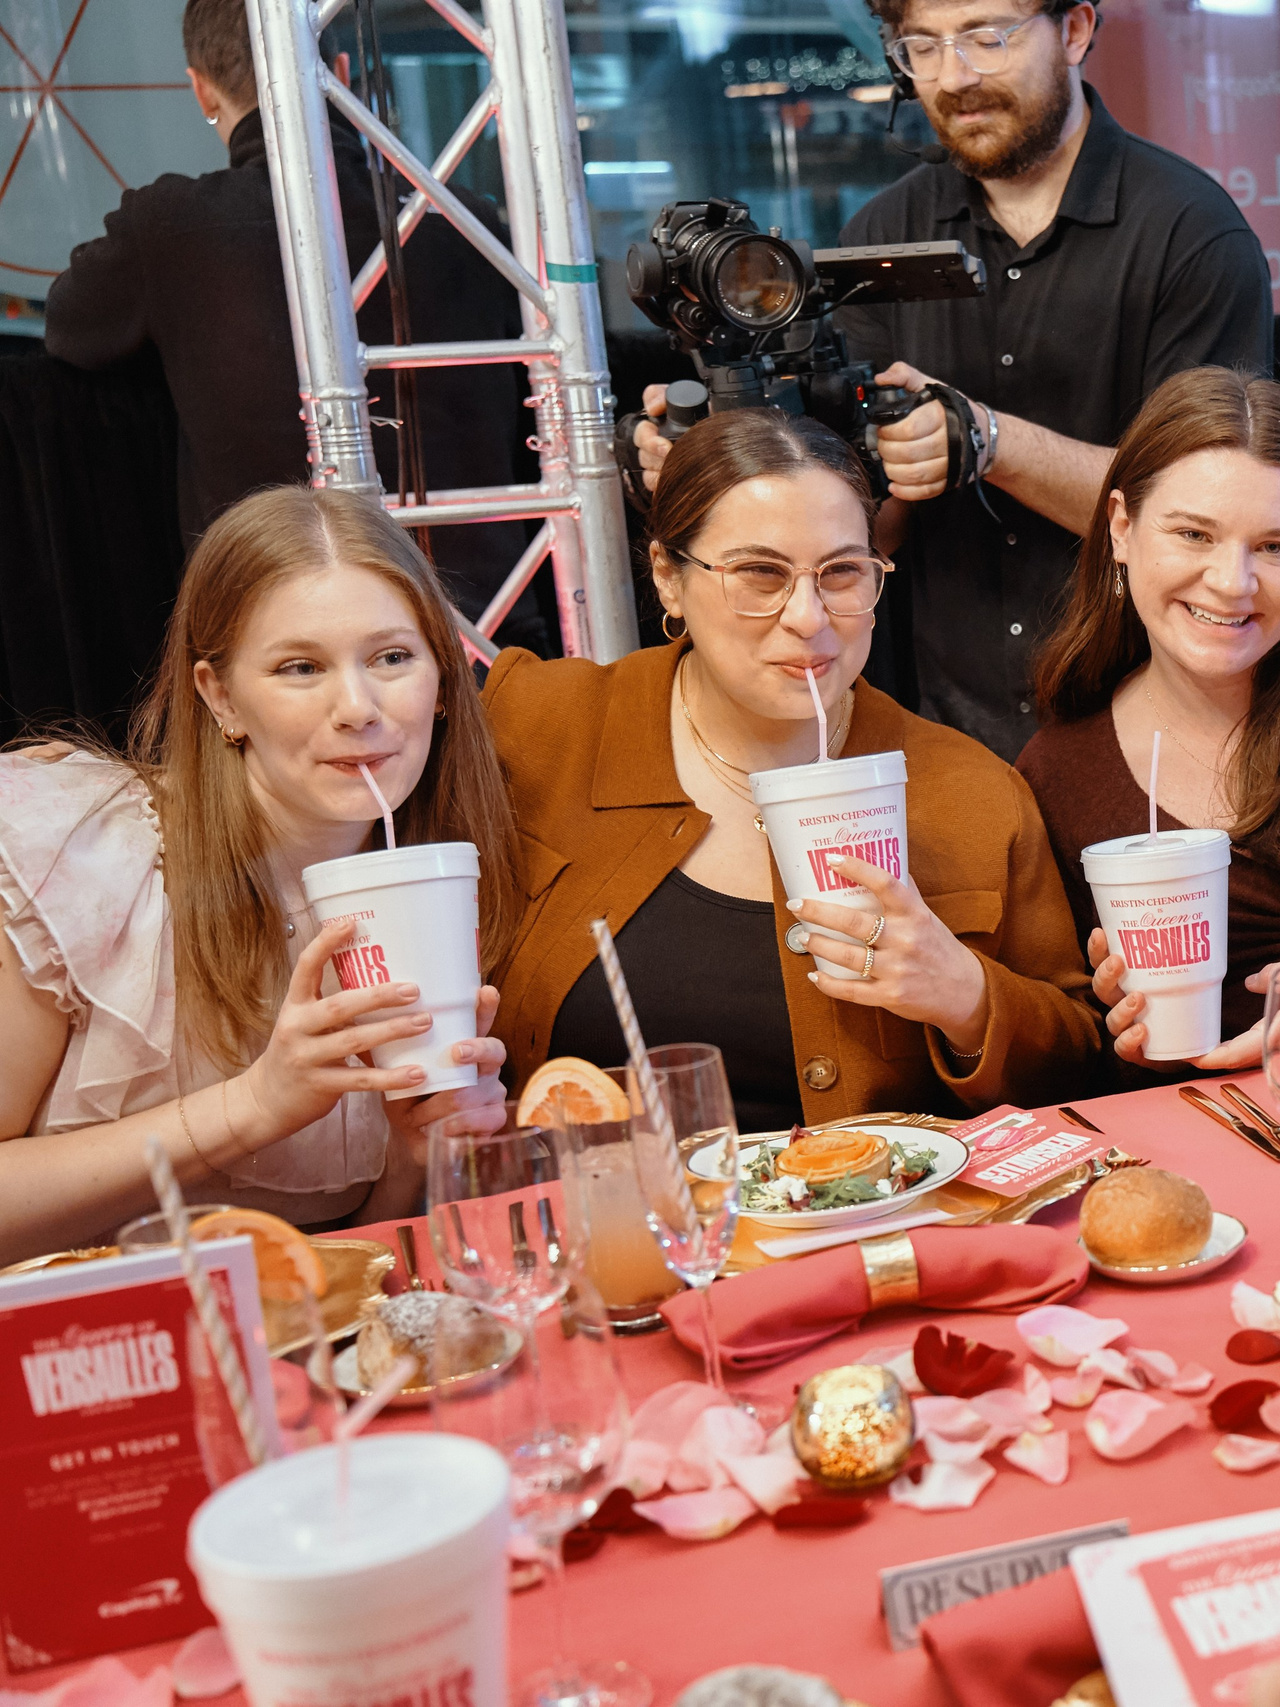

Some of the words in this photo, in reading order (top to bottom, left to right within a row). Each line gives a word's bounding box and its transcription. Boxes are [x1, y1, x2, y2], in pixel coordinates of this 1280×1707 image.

[798, 813, 840, 828] KRISTIN
[841, 804, 898, 821] CHENOWETH
[812, 837, 834, 847] THE
[834, 826, 884, 844] Queen
[884, 828, 894, 836] OF
[1110, 899, 1146, 908] KRISTIN
[1146, 889, 1209, 906] CHENOWETH
[1121, 920, 1139, 928] THE
[1140, 911, 1191, 928] Queen
[1192, 912, 1203, 921] OF
[358, 935, 371, 944] OF
[1117, 920, 1210, 970] VERSAILLES
[1166, 967, 1190, 975] MUSICAL
[975, 1131, 1092, 1185] VERSAILLES
[20, 1330, 181, 1417] VERSAILLES
[50, 1450, 86, 1472] GET
[117, 1433, 180, 1459] TOUCH
